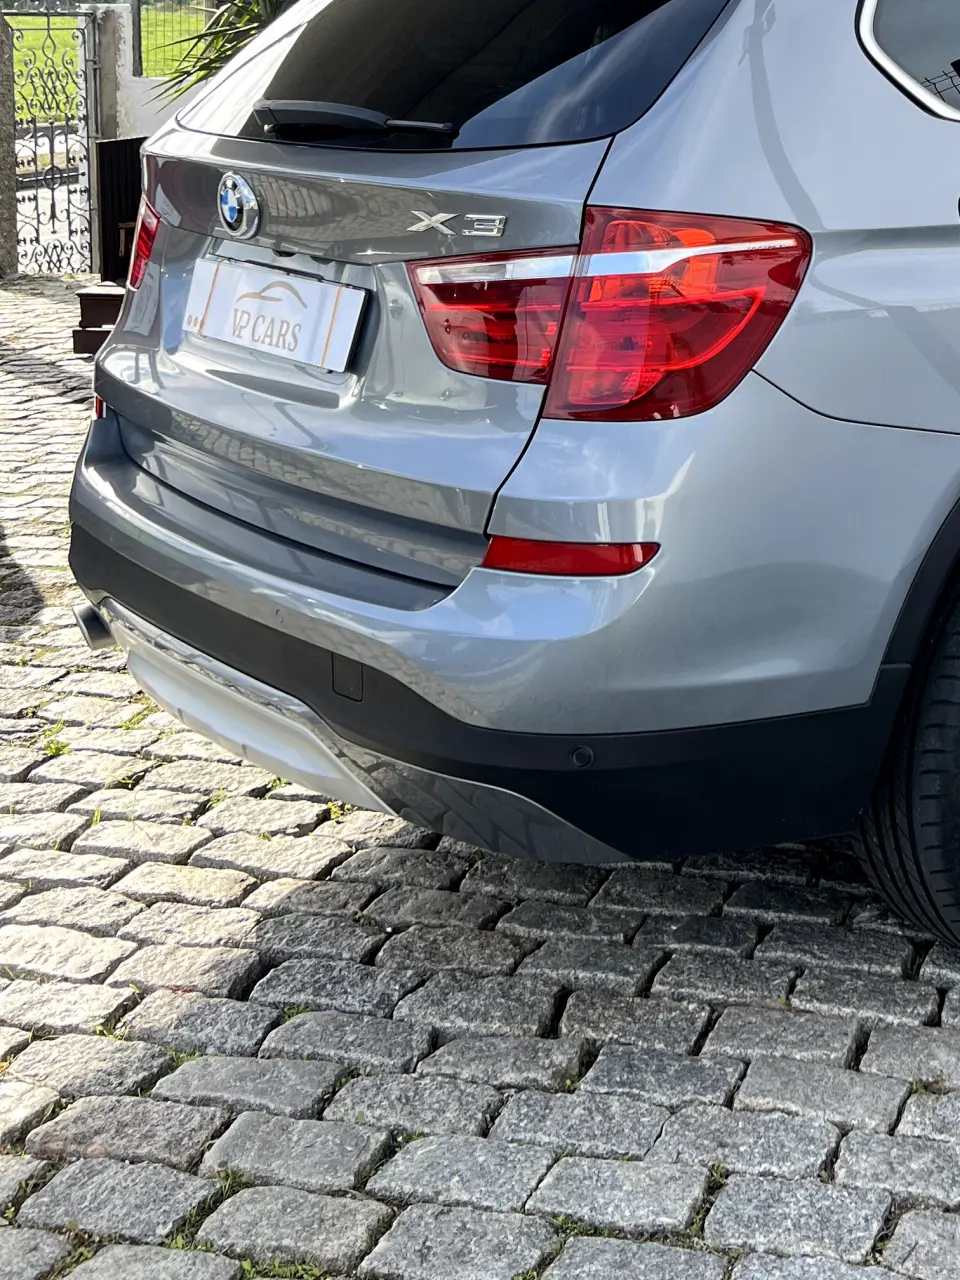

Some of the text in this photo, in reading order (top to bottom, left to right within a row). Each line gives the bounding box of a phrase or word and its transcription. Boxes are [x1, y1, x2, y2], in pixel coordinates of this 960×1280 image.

[406, 210, 507, 237] X3
[232, 308, 302, 353] VP CARS
